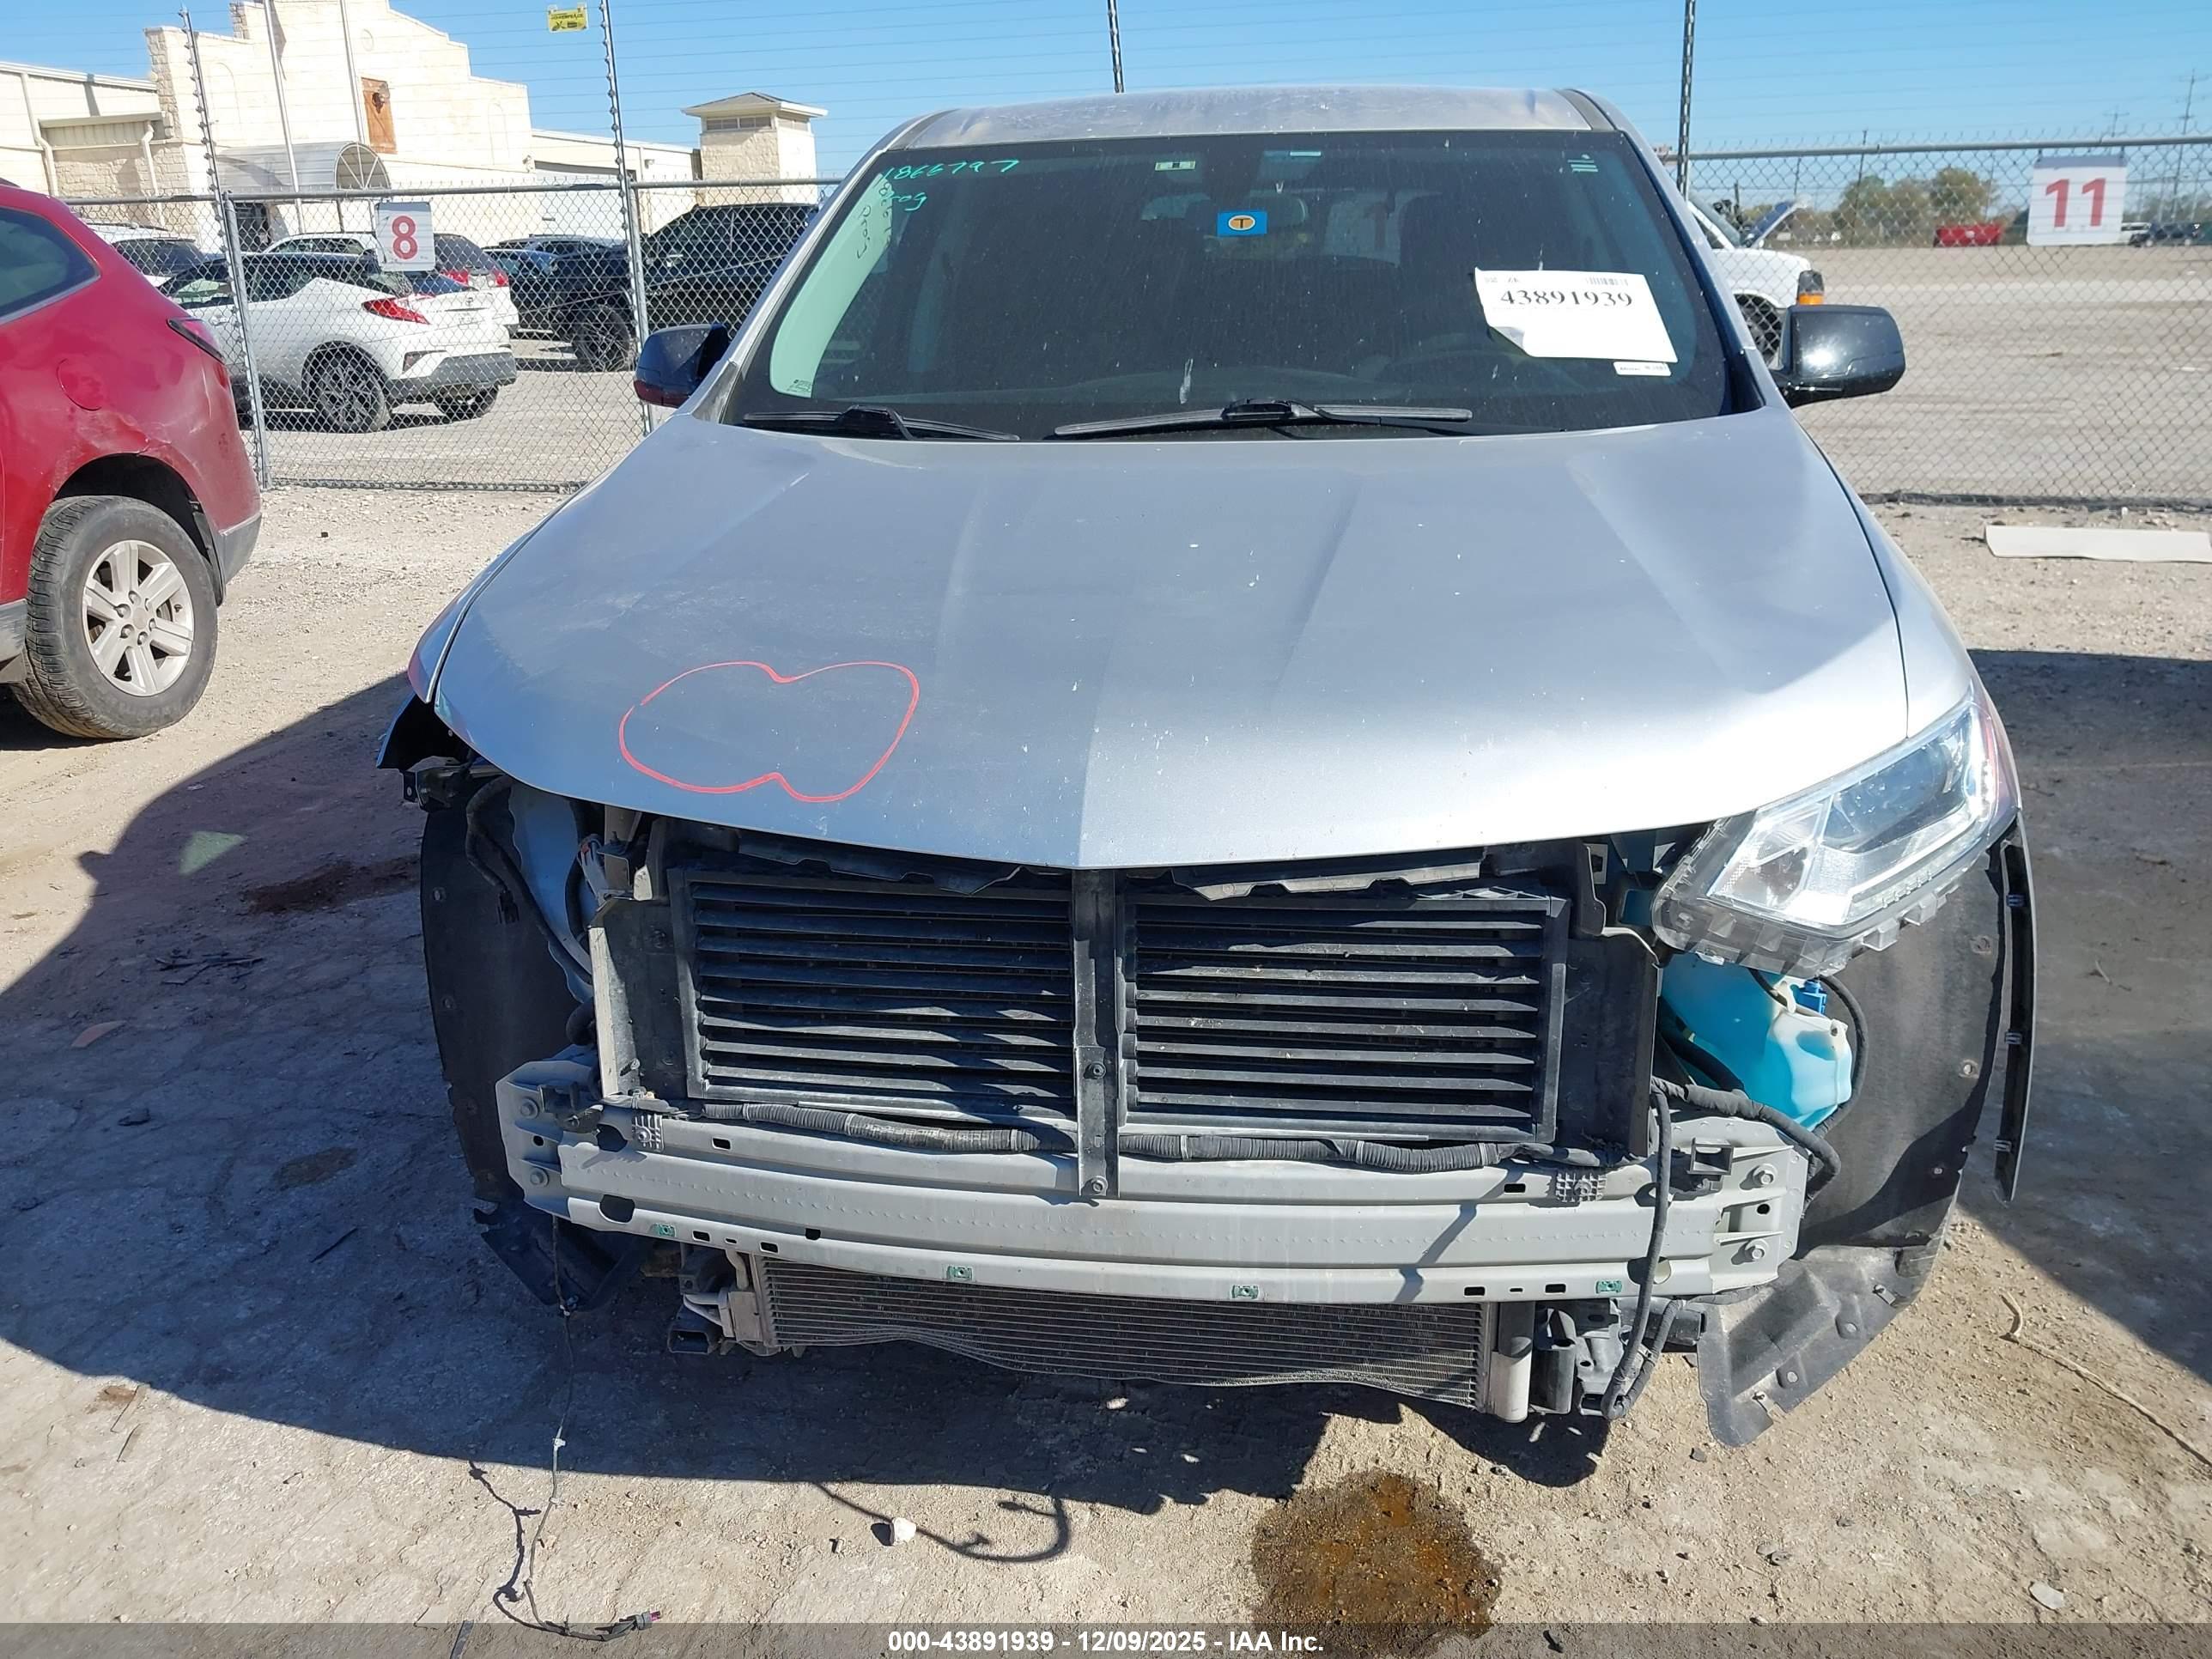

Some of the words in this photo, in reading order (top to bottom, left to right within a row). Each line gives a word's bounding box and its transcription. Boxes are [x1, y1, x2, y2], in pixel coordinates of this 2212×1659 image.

[2045, 177, 2106, 228] 11
[392, 216, 418, 259] 8
[1500, 289, 1632, 307] 43891939
